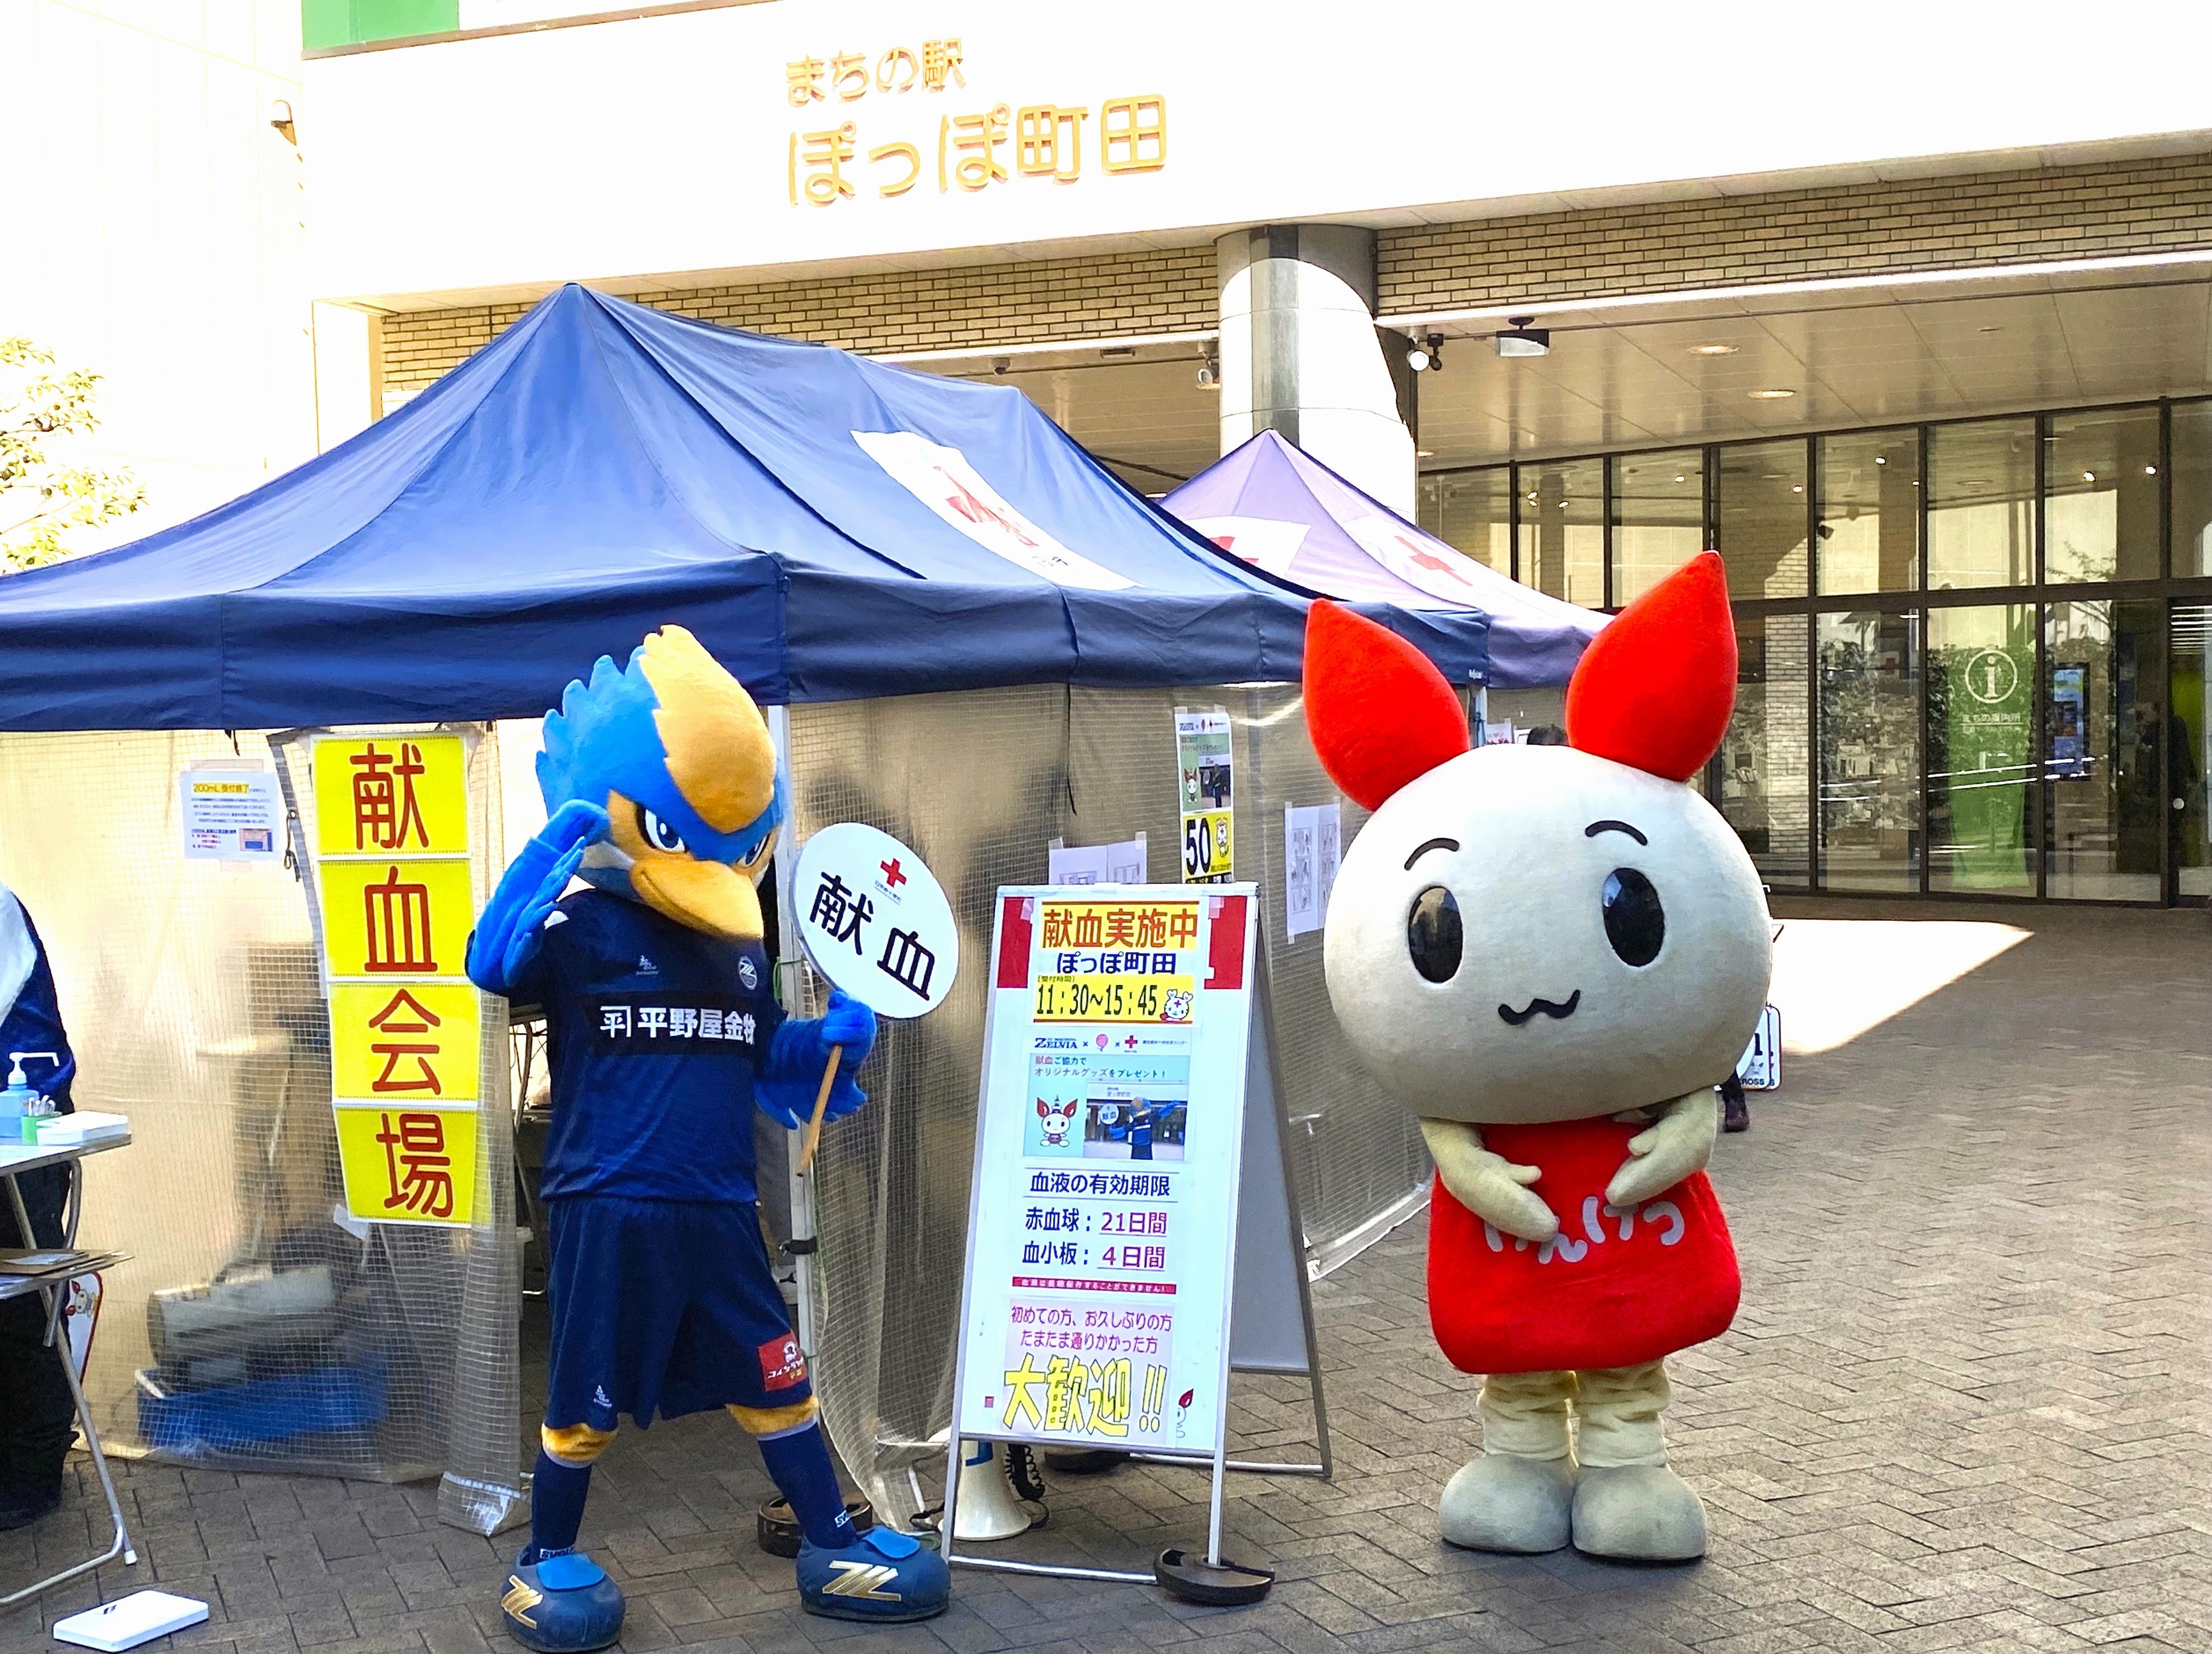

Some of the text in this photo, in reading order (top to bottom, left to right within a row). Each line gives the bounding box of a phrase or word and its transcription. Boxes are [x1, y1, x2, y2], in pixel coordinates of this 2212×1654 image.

[786, 37, 966, 107] まちの駅
[788, 94, 1167, 208] ぽっぽ町田
[809, 872, 935, 1001] 献血
[1042, 908, 1198, 948] 献血実施中
[1057, 951, 1177, 975] ぽっぽ町田
[349, 743, 454, 1217] 献血会場
[1035, 1038, 1078, 1048] ZELVIA
[1035, 1055, 1087, 1065] 献血ご協力で
[1029, 1171, 1171, 1196] 血液の有効期限
[1011, 1306, 1172, 1331] 初めての方、お久しぶりの方
[1020, 1330, 1158, 1354] たまたま通りかかった方
